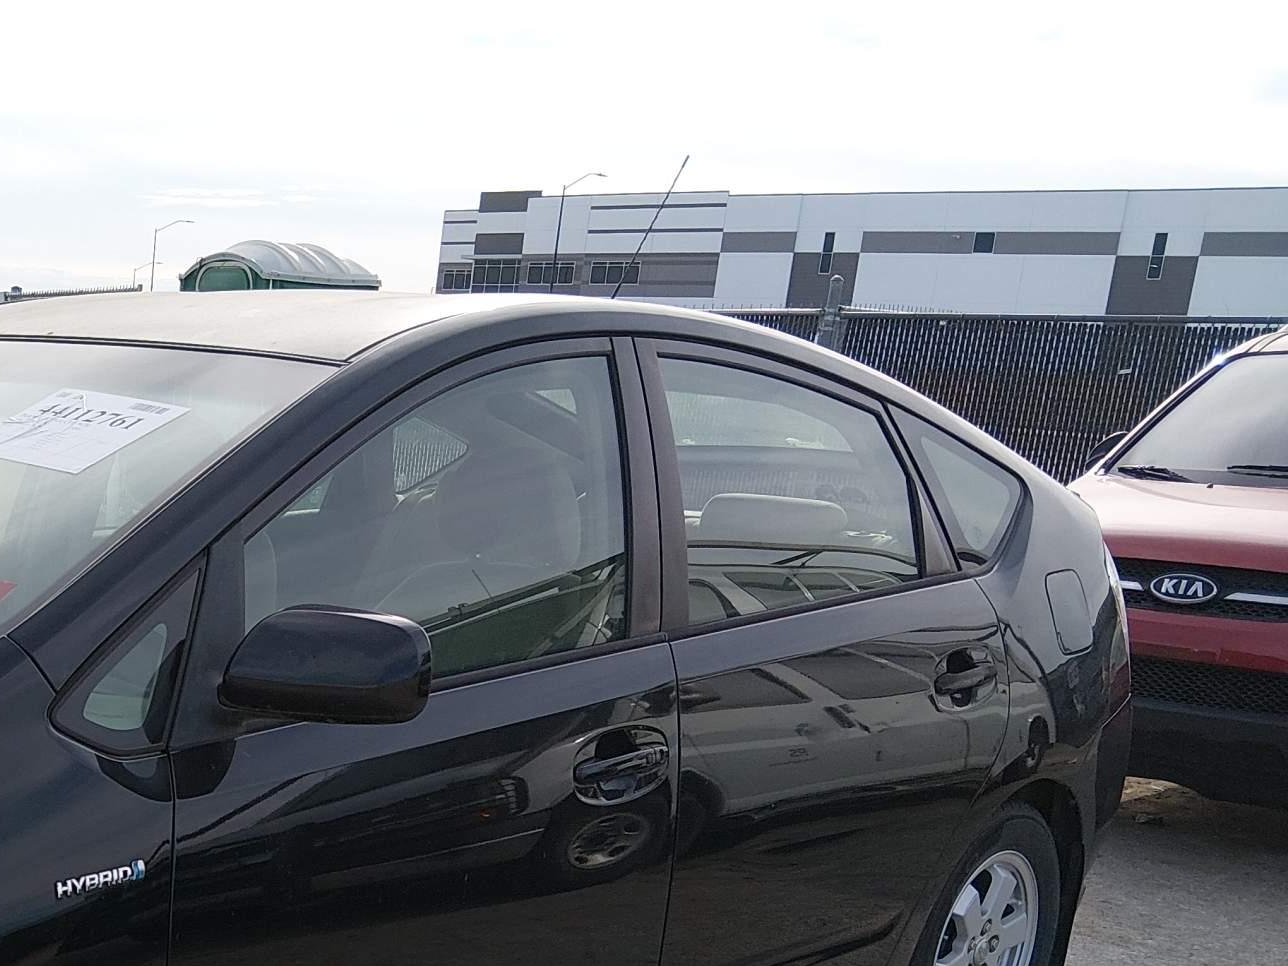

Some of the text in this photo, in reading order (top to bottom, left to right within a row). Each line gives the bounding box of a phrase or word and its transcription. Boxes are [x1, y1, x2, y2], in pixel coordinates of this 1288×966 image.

[39, 403, 145, 430] 44112761
[1161, 577, 1204, 598] KIA
[55, 865, 132, 899] HYBRID
